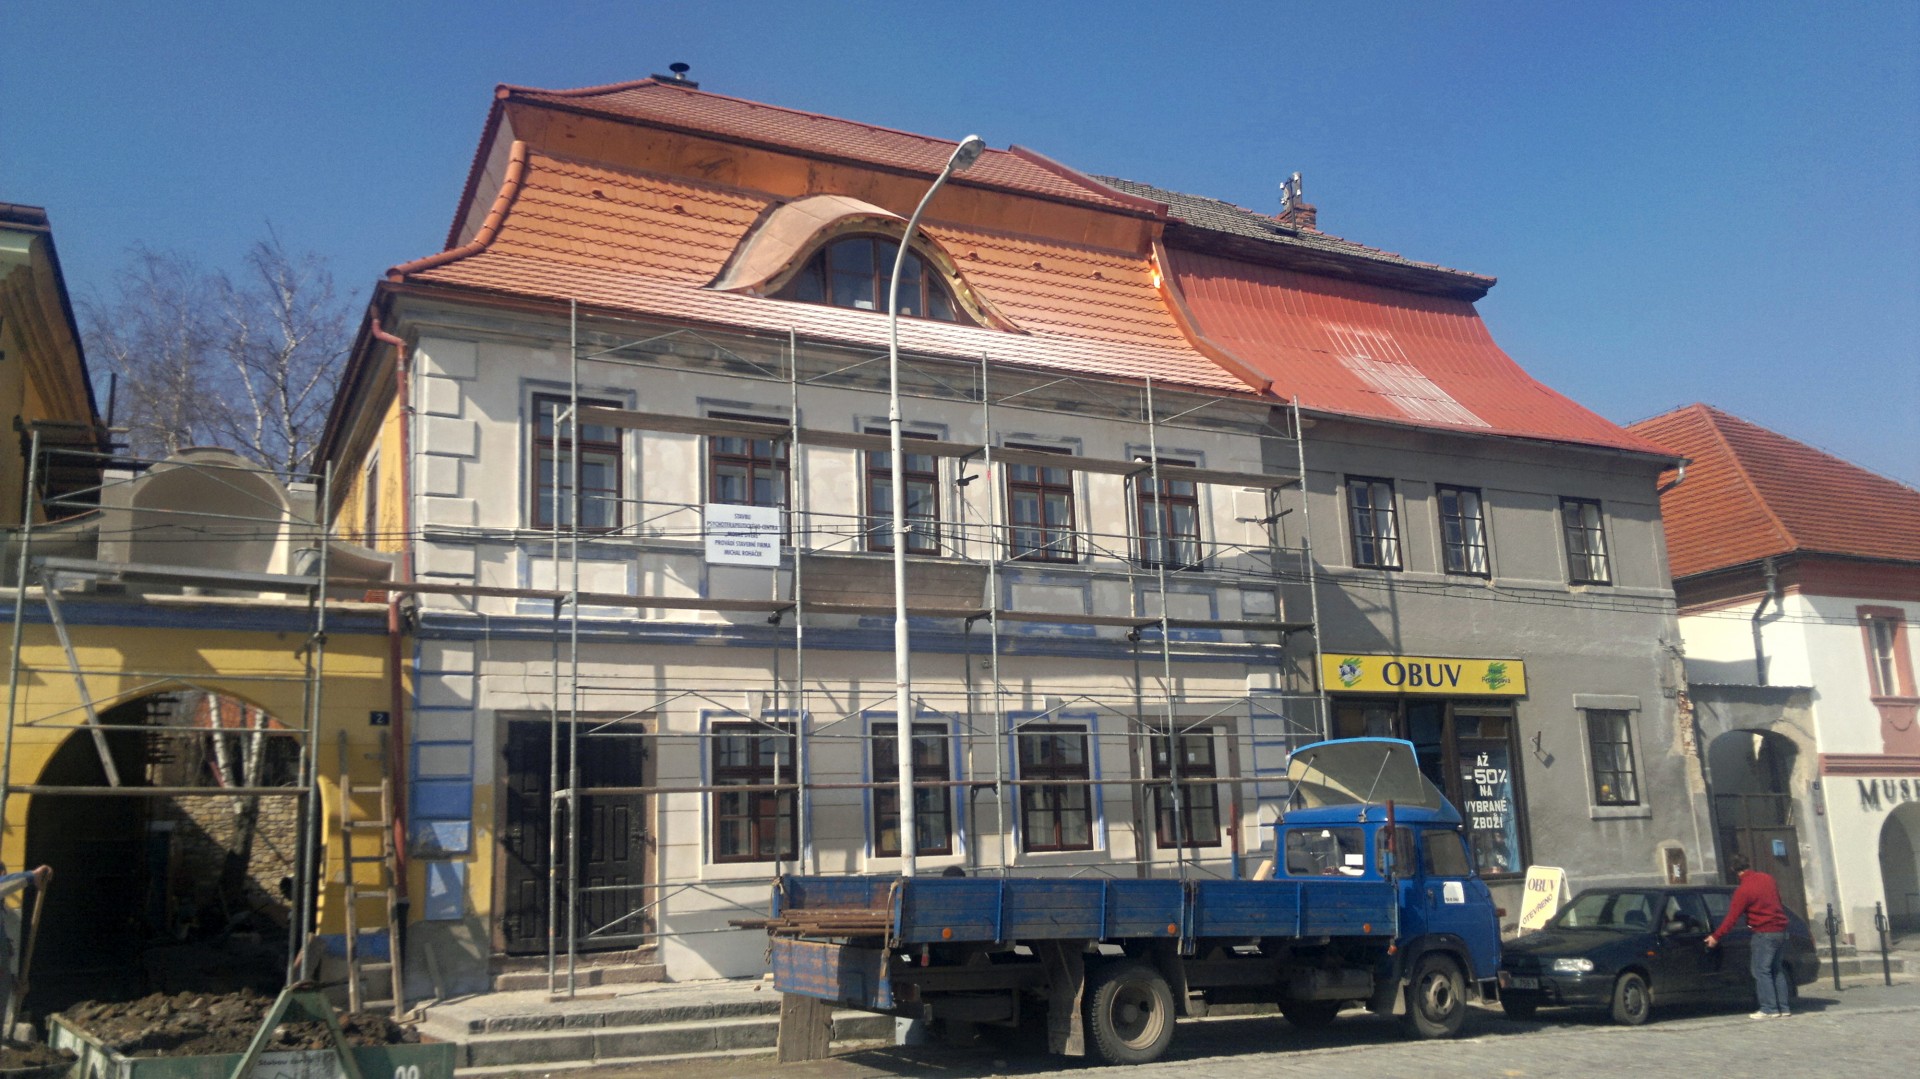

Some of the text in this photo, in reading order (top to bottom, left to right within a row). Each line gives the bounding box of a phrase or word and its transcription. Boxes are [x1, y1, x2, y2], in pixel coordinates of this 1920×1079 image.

[1382, 661, 1462, 687] OBUV
[1476, 751, 1490, 767] AŽ
[1463, 768, 1508, 785] -50%
[1480, 785, 1493, 797] NA
[1464, 796, 1508, 813] VYBRANÉ
[1472, 812, 1503, 829] ZBOŽÍ
[1528, 878, 1557, 892] OBUV
